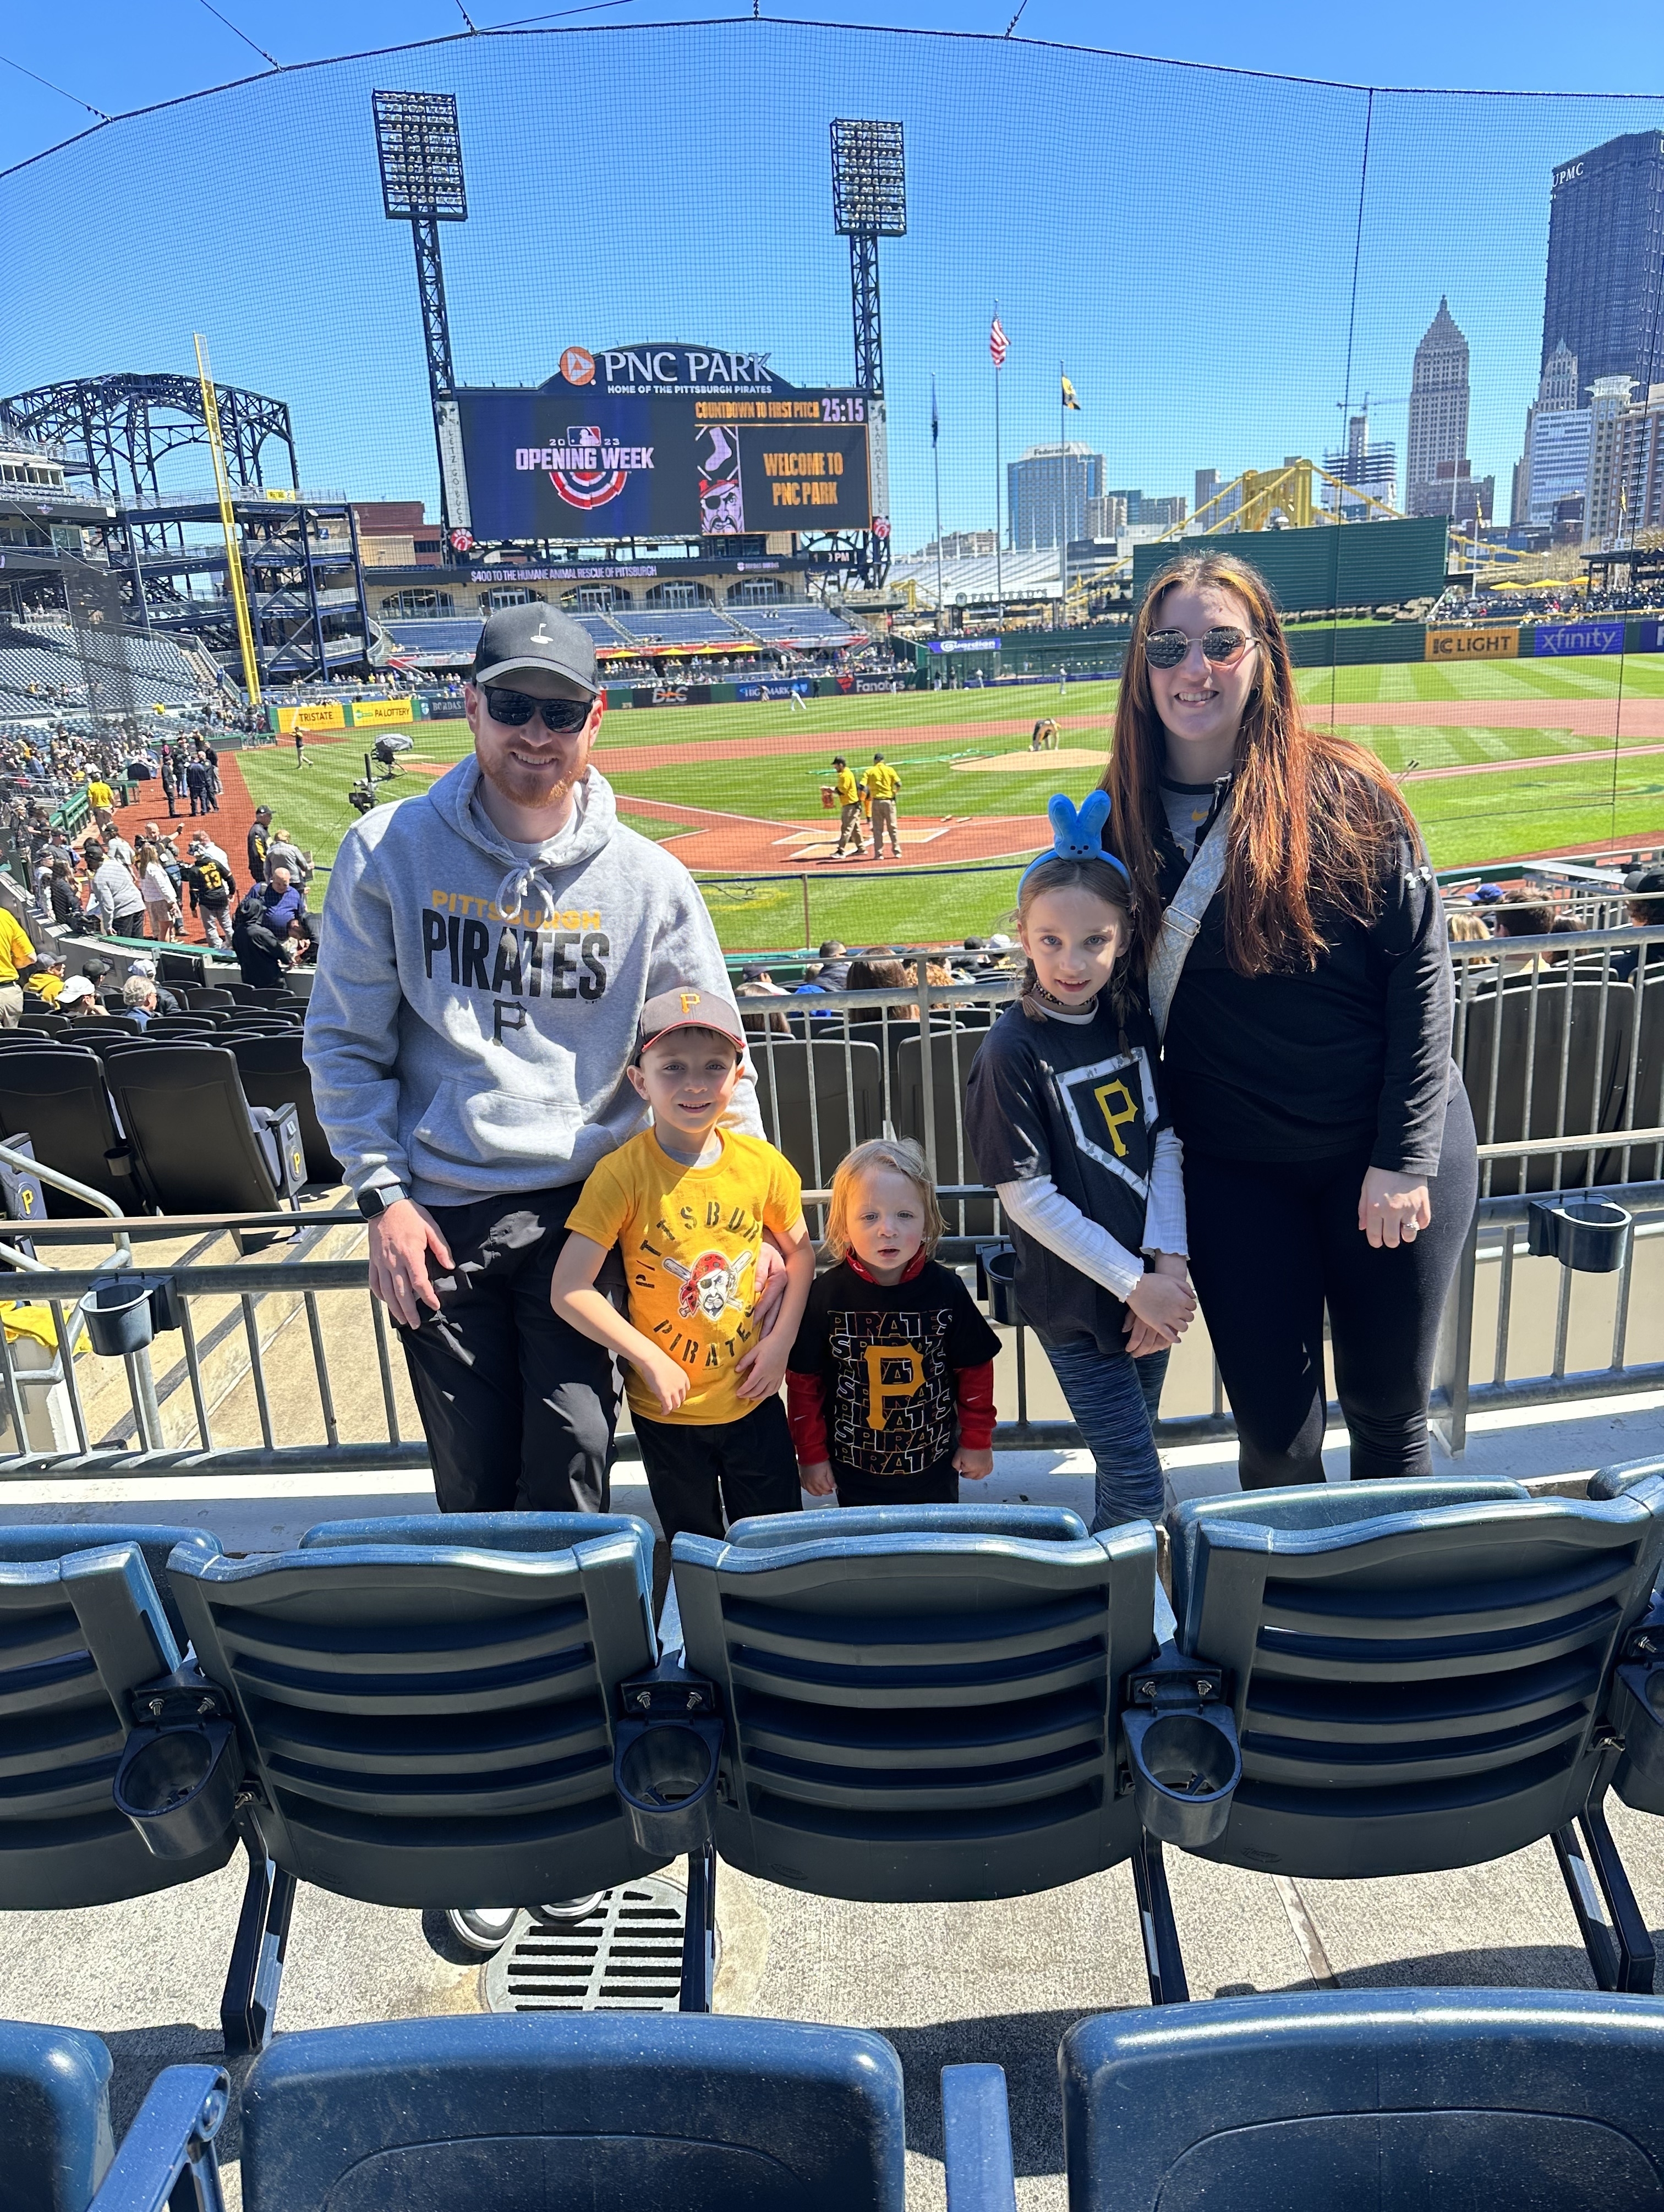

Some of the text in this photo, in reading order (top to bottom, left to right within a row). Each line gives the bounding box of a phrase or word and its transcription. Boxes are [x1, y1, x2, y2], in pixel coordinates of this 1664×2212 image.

[1552, 162, 1584, 187] UPMC
[600, 352, 773, 382] PNC PARK
[607, 385, 773, 394] HOME OF THE PITTSBURGH PIRATES
[695, 401, 820, 418] COUNTDOWN TO FIRST PITCH
[822, 398, 864, 422] 25:15
[448, 429, 457, 464] LETZ
[516, 447, 654, 470] OPENING WEEK
[763, 452, 844, 476] WELCOME TO
[452, 469, 459, 485] GO
[772, 482, 838, 506] PNC PARK
[835, 552, 850, 562] PM
[471, 566, 657, 583] $400 TO THE HUMANE ANIMAL RESCUE OF PITTSBURGH
[940, 640, 996, 652] Guardian
[1457, 636, 1511, 652] LIGHT
[1542, 627, 1616, 654] xfinity
[652, 687, 688, 704] DLC
[745, 686, 790, 697] HIGMARK
[299, 711, 333, 722] TRISTATE
[375, 707, 410, 717] PA LOTTERY
[432, 701, 462, 711] BORDAS
[433, 890, 601, 930] PITTSBURGH
[422, 908, 610, 1000] PIRATES
[680, 993, 700, 1013] P
[492, 999, 528, 1046] P
[1094, 1078, 1138, 1157] P
[294, 1152, 300, 1174] P
[22, 1189, 34, 1215] P
[635, 1201, 760, 1289] PITTSBUR
[827, 1309, 953, 1337] PIRATES
[863, 1342, 927, 1430] P
